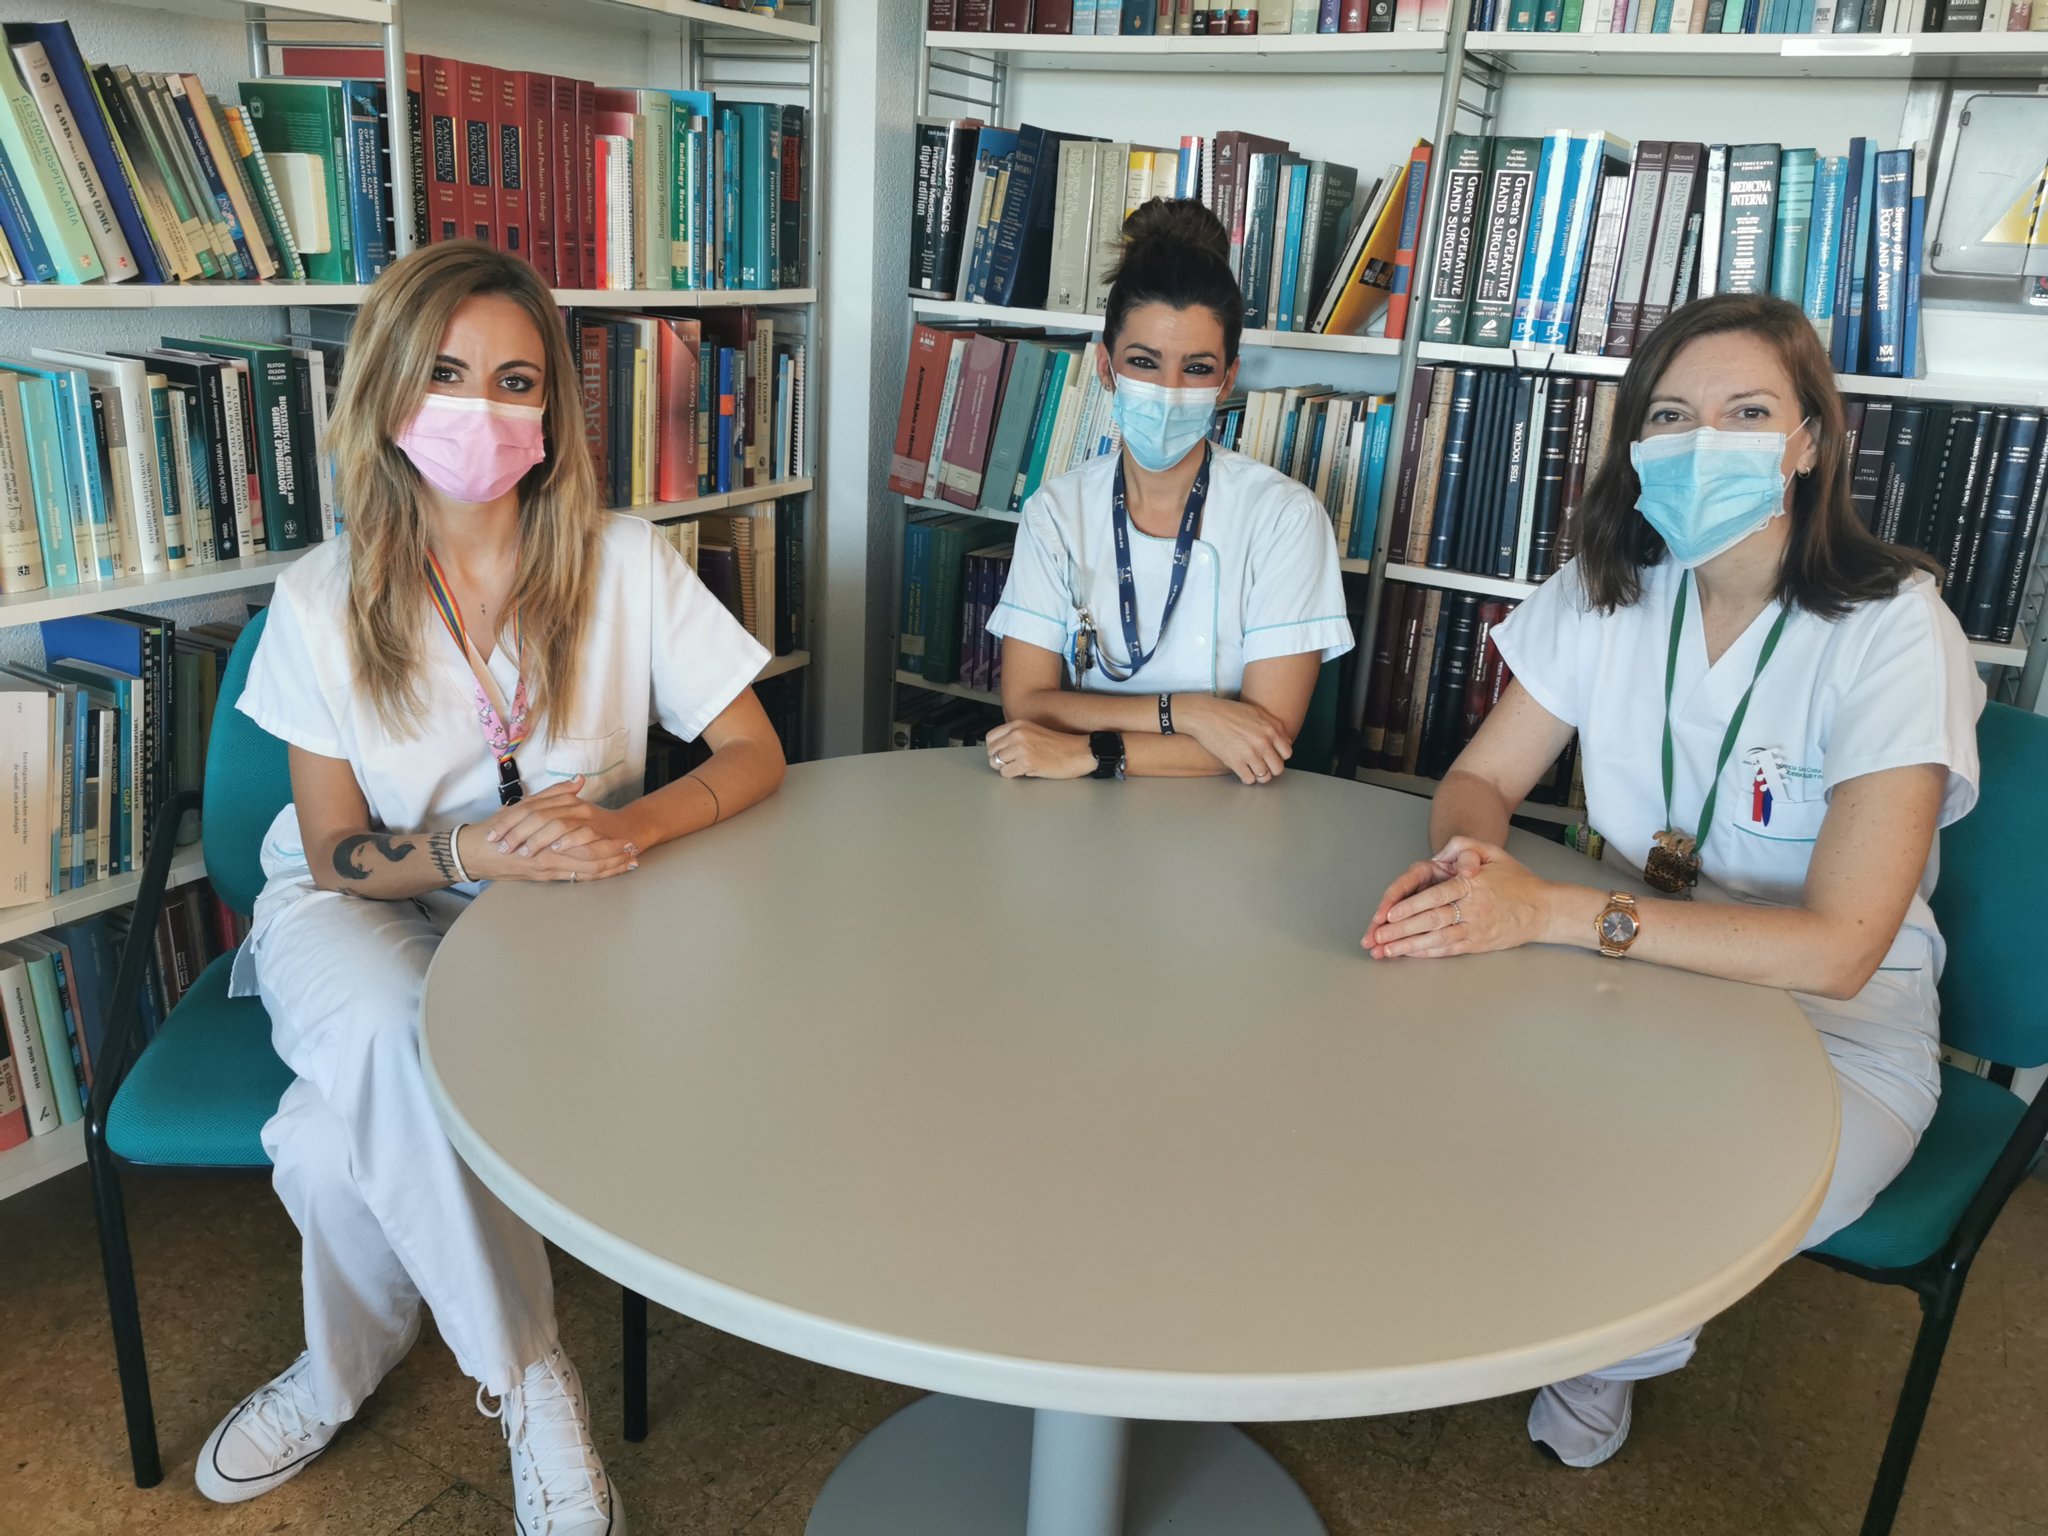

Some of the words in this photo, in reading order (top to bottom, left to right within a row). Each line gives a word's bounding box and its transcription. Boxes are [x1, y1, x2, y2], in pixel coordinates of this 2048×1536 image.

[19, 93, 47, 143] GESTIÓN
[40, 146, 79, 226] HOSPITALARIA
[356, 127, 367, 193] ORGANIZATIONS
[363, 141, 371, 174] HEALTH
[368, 128, 377, 173] STRATEGIC
[412, 129, 423, 190] TRAUMATIC
[433, 121, 446, 176] UROLOGY
[440, 118, 454, 180] CAMPBELL'S
[467, 125, 481, 181] UROLOGY
[474, 122, 489, 184] CAMPBELL'S
[500, 129, 513, 184] UROLOGY
[506, 127, 520, 187] CAMPBELL'S
[656, 124, 665, 191] Gastrointestinal
[917, 145, 931, 177] digital
[929, 146, 939, 184] Internal
[1222, 145, 1232, 158] 4
[366, 176, 374, 200] CARE
[372, 175, 382, 232] MANAGEMENT
[416, 191, 425, 214] AND
[916, 180, 928, 215] edition
[1449, 175, 1463, 213] HAND
[1461, 175, 1478, 224] Green's
[1495, 175, 1511, 213] HAND
[1508, 176, 1526, 224] Green's
[1641, 174, 1656, 209] SPINE
[1673, 175, 1688, 211] SPINE
[1730, 180, 1771, 193] MEDICINA
[1731, 194, 1768, 206] INTERNA
[925, 187, 935, 233] Medicine
[1534, 220, 1540, 228] de
[1564, 222, 1570, 230] de
[1879, 208, 1893, 237] FOOT
[1891, 206, 1904, 241] Surgery
[1440, 215, 1458, 273] SURGERY
[1486, 216, 1505, 275] SURGERY
[1632, 211, 1651, 266] SURGERY
[1662, 212, 1682, 268] SURGERY
[1878, 241, 1889, 267] AND
[1891, 243, 1901, 254] of
[1450, 226, 1470, 296] OPERATIVE
[1497, 227, 1518, 298] OPERATIVE
[1892, 256, 1902, 271] the
[1877, 271, 1889, 311] ANKLE
[225, 385, 231, 397] EN
[226, 400, 232, 411] LA
[232, 388, 237, 398] LA
[583, 362, 600, 442] HEART
[227, 414, 237, 455] PRÁCTICA
[233, 402, 243, 450] DIRECCIÓN
[270, 406, 282, 438] GENETIC
[277, 396, 291, 453] BIOSTATISTICAL
[1509, 420, 1525, 462] DOCTORAL
[215, 442, 224, 475] SANITARIA
[273, 439, 286, 495] EPIDEMIOLOGY
[282, 455, 294, 490] GENETICS
[1508, 464, 1519, 483] TESIS
[218, 477, 226, 503] GESTIÓN
[232, 459, 241, 514] EMPRESARIAL
[238, 453, 248, 509] ESTRATÉGICA
[285, 491, 294, 504] AND
[1948, 532, 1962, 570] DOCTORAL
[1161, 712, 1169, 726] DE
[65, 744, 71, 754] LA
[64, 798, 70, 810] NO
[13, 986, 26, 1015] Disciplina
[20, 1015, 29, 1034] Quinta
[25, 1034, 31, 1042] La
